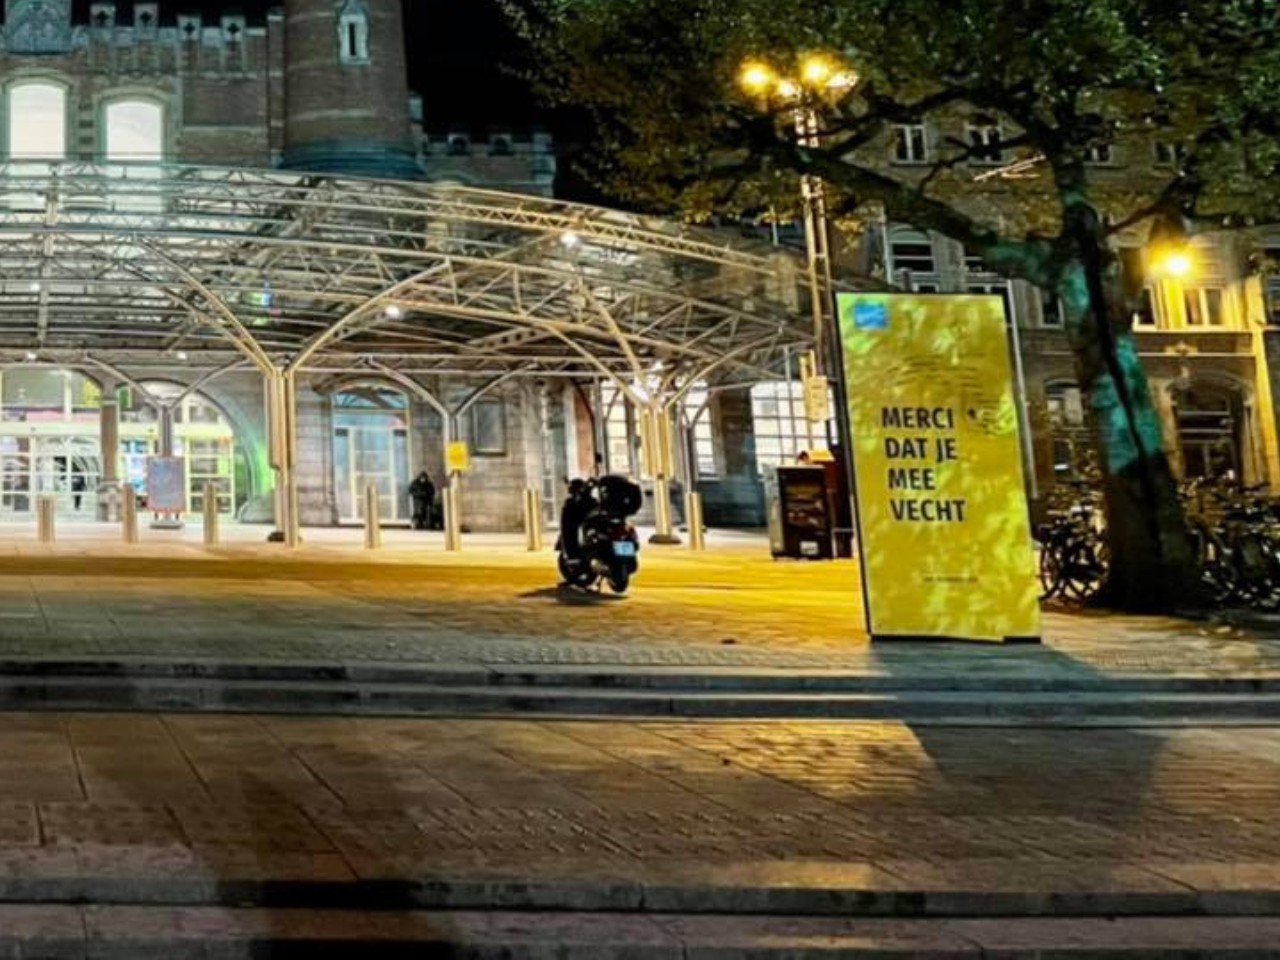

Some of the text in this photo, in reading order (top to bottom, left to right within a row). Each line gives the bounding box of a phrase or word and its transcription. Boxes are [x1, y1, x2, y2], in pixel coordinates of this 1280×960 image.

[881, 406, 954, 429] MERCI
[884, 437, 958, 463] DAT JE
[888, 467, 935, 490] MEE
[889, 499, 965, 522] VECHT
